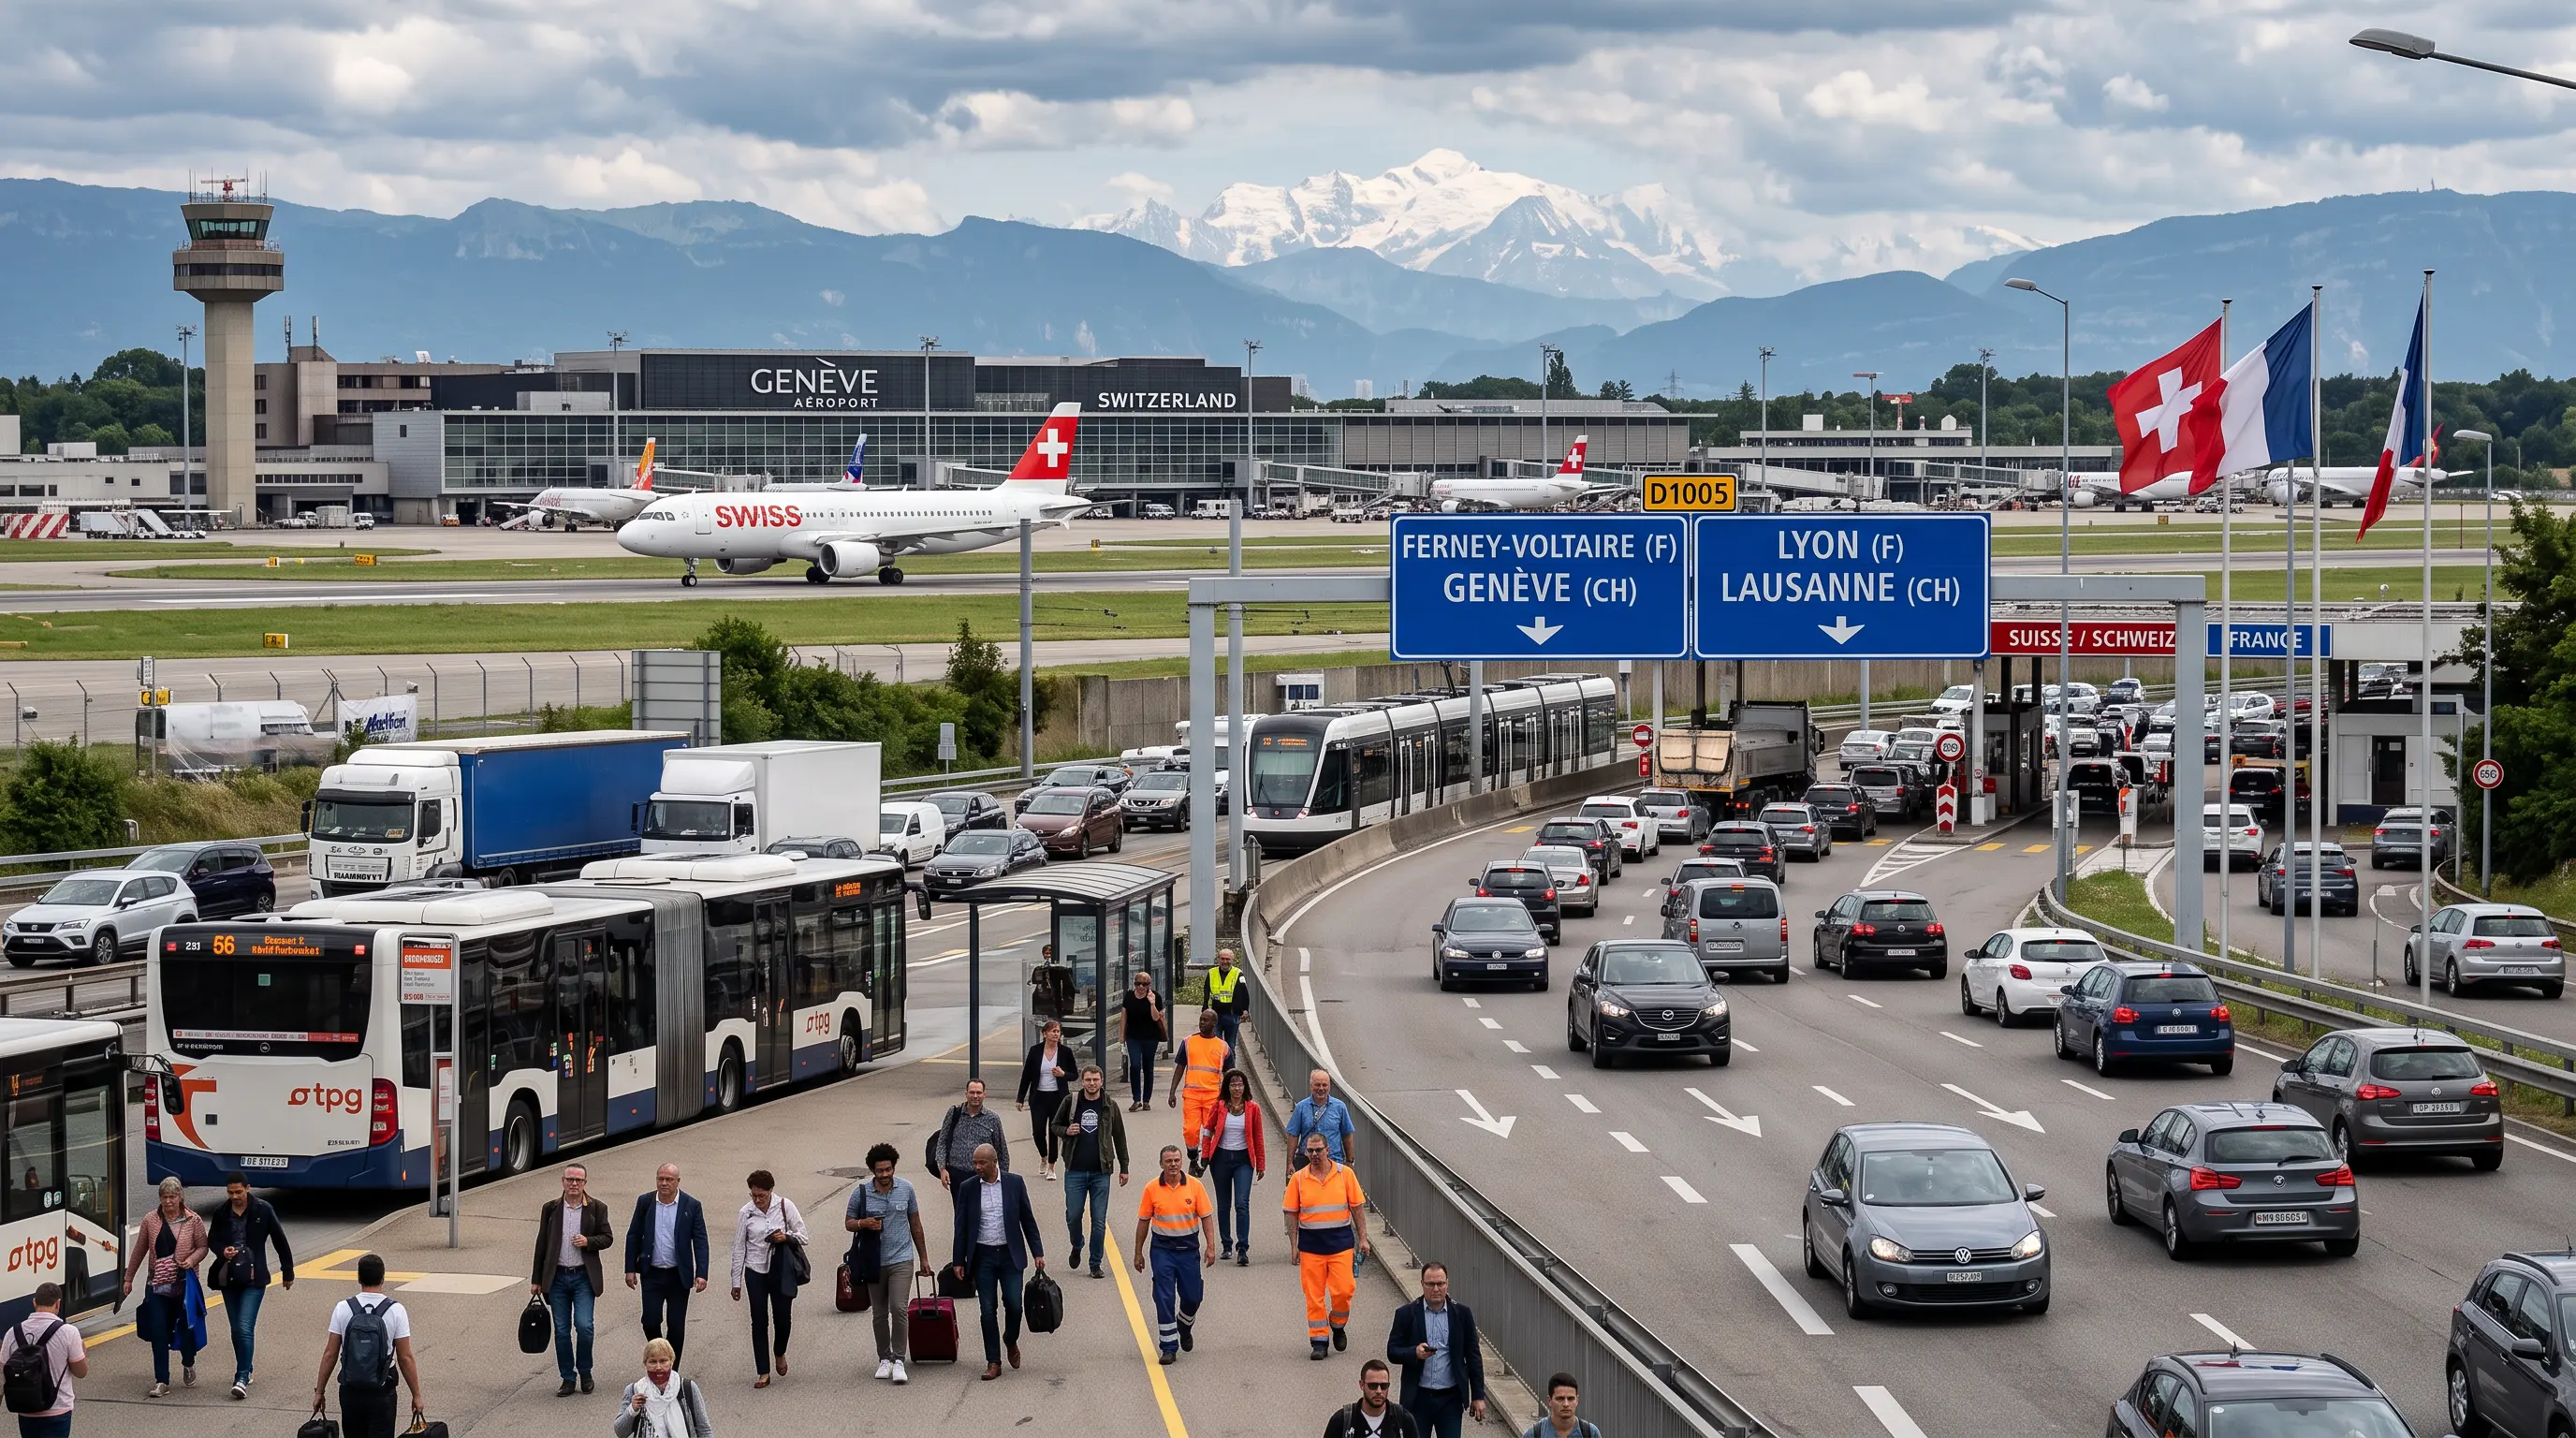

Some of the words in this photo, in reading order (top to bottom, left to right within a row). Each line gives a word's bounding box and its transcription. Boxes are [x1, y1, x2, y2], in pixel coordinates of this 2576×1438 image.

[751, 357, 878, 394] GENÈVE
[794, 396, 878, 408] AÉROPORT
[1098, 392, 1237, 408] SWITZERLAND
[1650, 482, 1728, 505] D1005
[715, 506, 802, 527] SWISS
[1403, 535, 1634, 559] FERNEY-VOLTAIRE
[1646, 534, 1676, 563] (F)
[1778, 530, 1858, 559] LYON
[1871, 534, 1904, 564] (F)
[1443, 566, 1571, 602] GENÈVE
[1584, 578, 1637, 607] (CH)
[1722, 573, 1895, 602] LAUSANNE
[1907, 577, 1960, 607] (CH)
[2009, 630, 2073, 646] SUISSE
[2092, 630, 2175, 647] SCHWEIZ
[213, 935, 235, 954] 56
